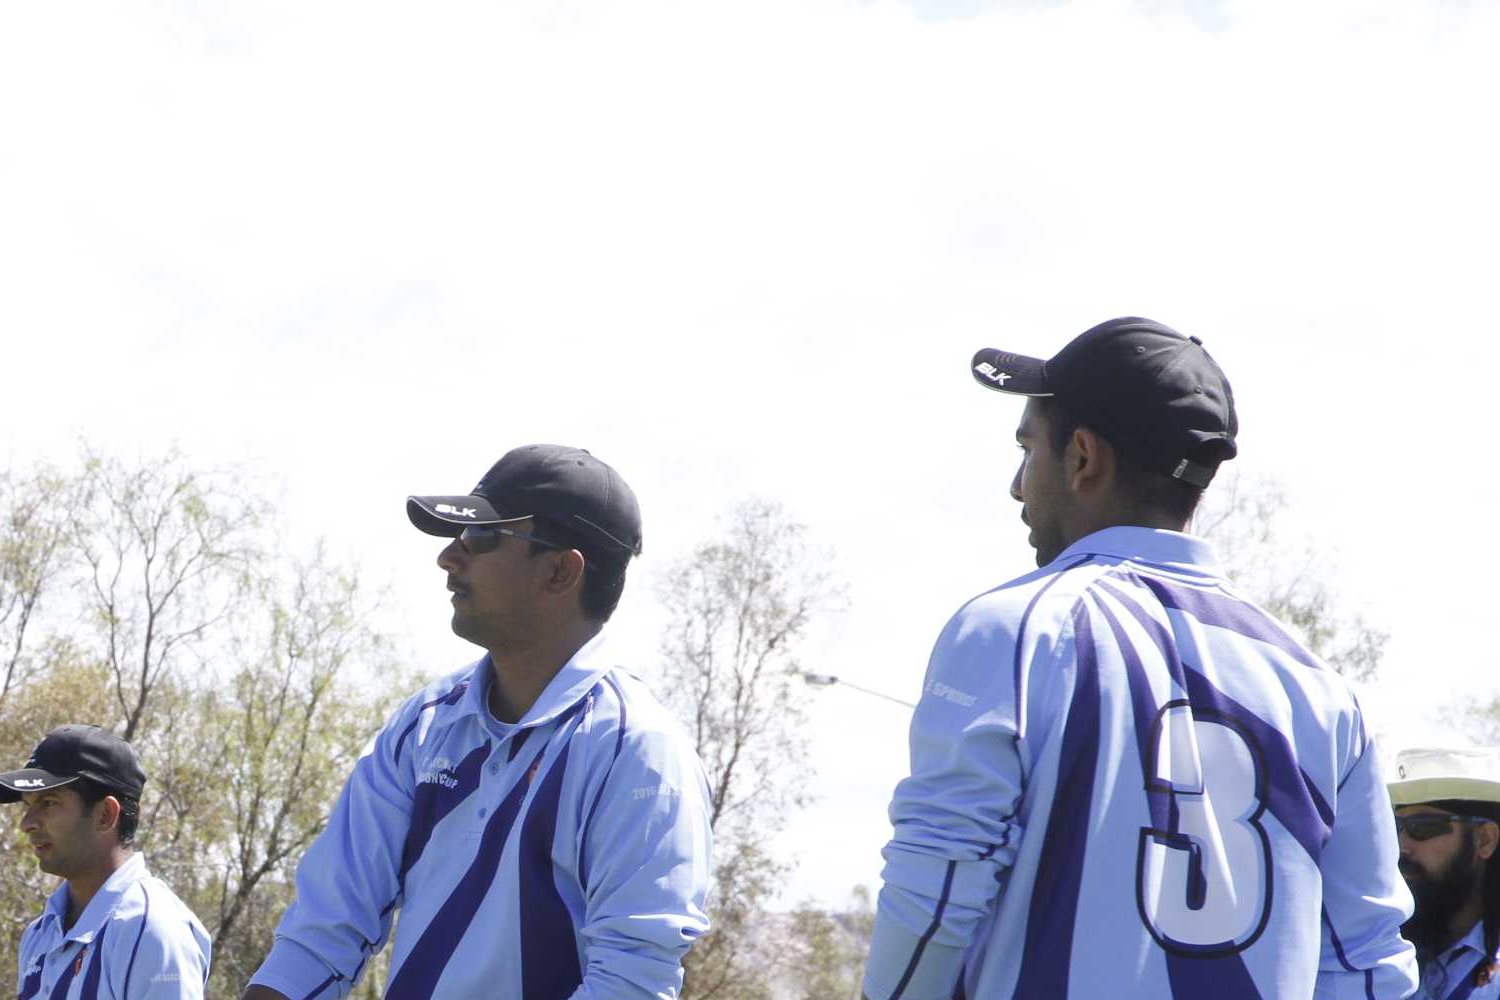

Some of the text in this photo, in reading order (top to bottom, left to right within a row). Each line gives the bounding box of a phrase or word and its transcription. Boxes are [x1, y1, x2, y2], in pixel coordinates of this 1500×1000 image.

[974, 361, 1012, 386] BLK
[435, 503, 477, 518] BLK
[1135, 698, 1274, 960] 3
